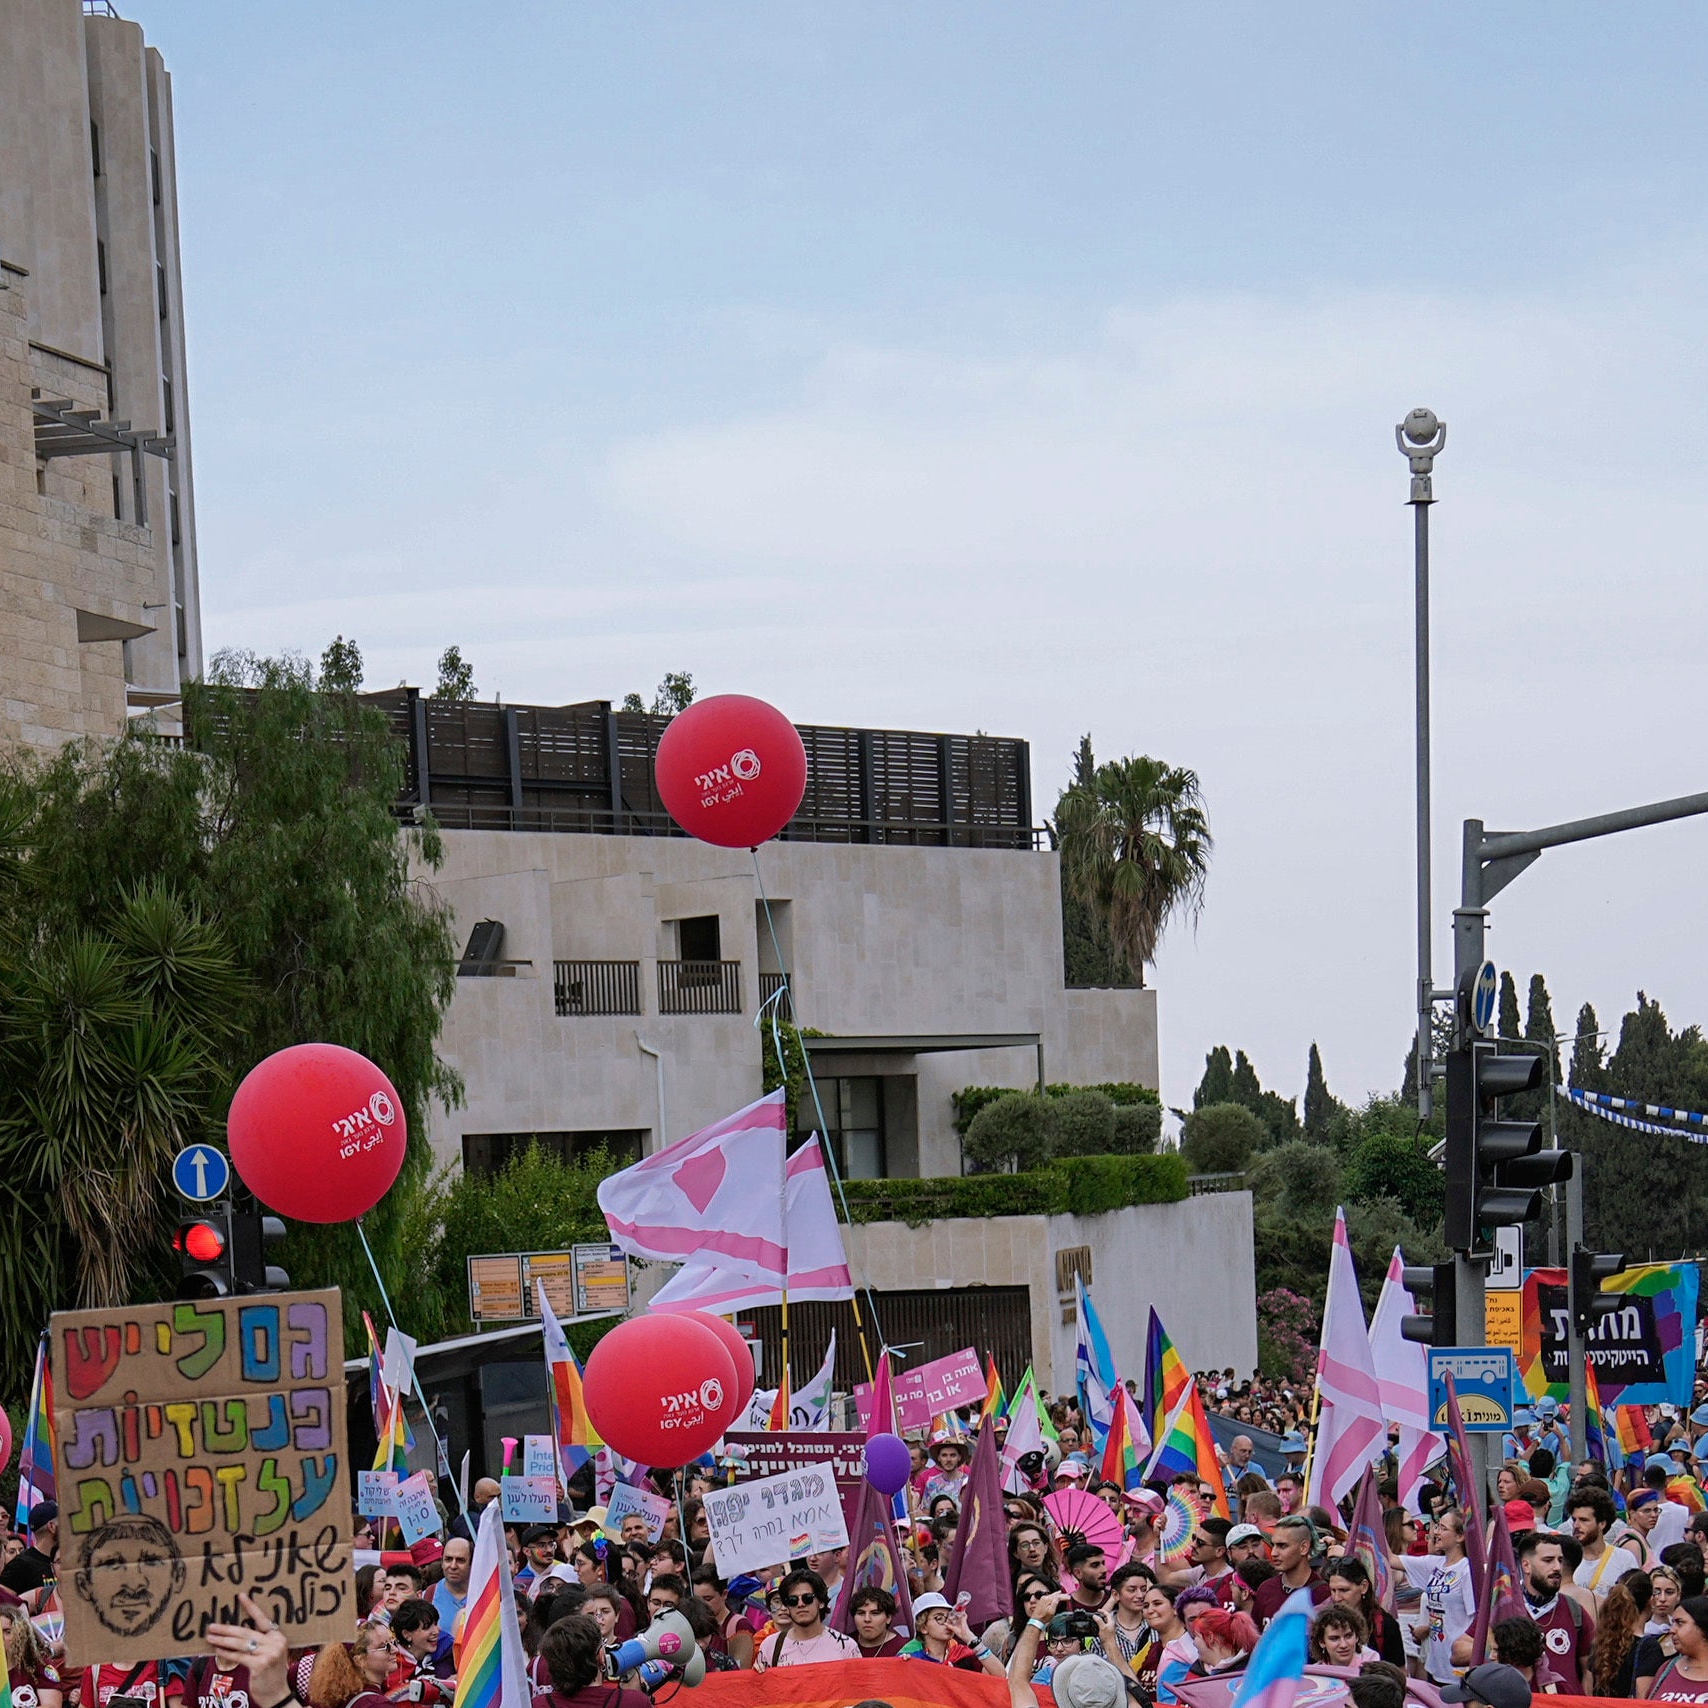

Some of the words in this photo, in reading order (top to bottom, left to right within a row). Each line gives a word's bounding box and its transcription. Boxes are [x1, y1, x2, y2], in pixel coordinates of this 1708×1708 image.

[694, 764, 731, 790] איגי
[701, 793, 719, 808] IGY
[332, 1107, 372, 1137] איגי
[340, 1140, 361, 1159] IGY
[156, 1303, 225, 1380] לי
[239, 1302, 328, 1382] גם
[63, 1321, 142, 1400] יש
[660, 1390, 699, 1413] איגי
[660, 1418, 682, 1430] IGY
[1474, 1412, 1501, 1422] מונית
[530, 1461, 554, 1471] Prid
[533, 1451, 554, 1460] Inte
[67, 1464, 247, 1536] זכויות
[252, 1453, 338, 1537] על
[791, 1503, 832, 1528] אמא
[752, 1516, 784, 1541] בחרה
[200, 1534, 255, 1587] לא
[255, 1525, 348, 1582] שאני
